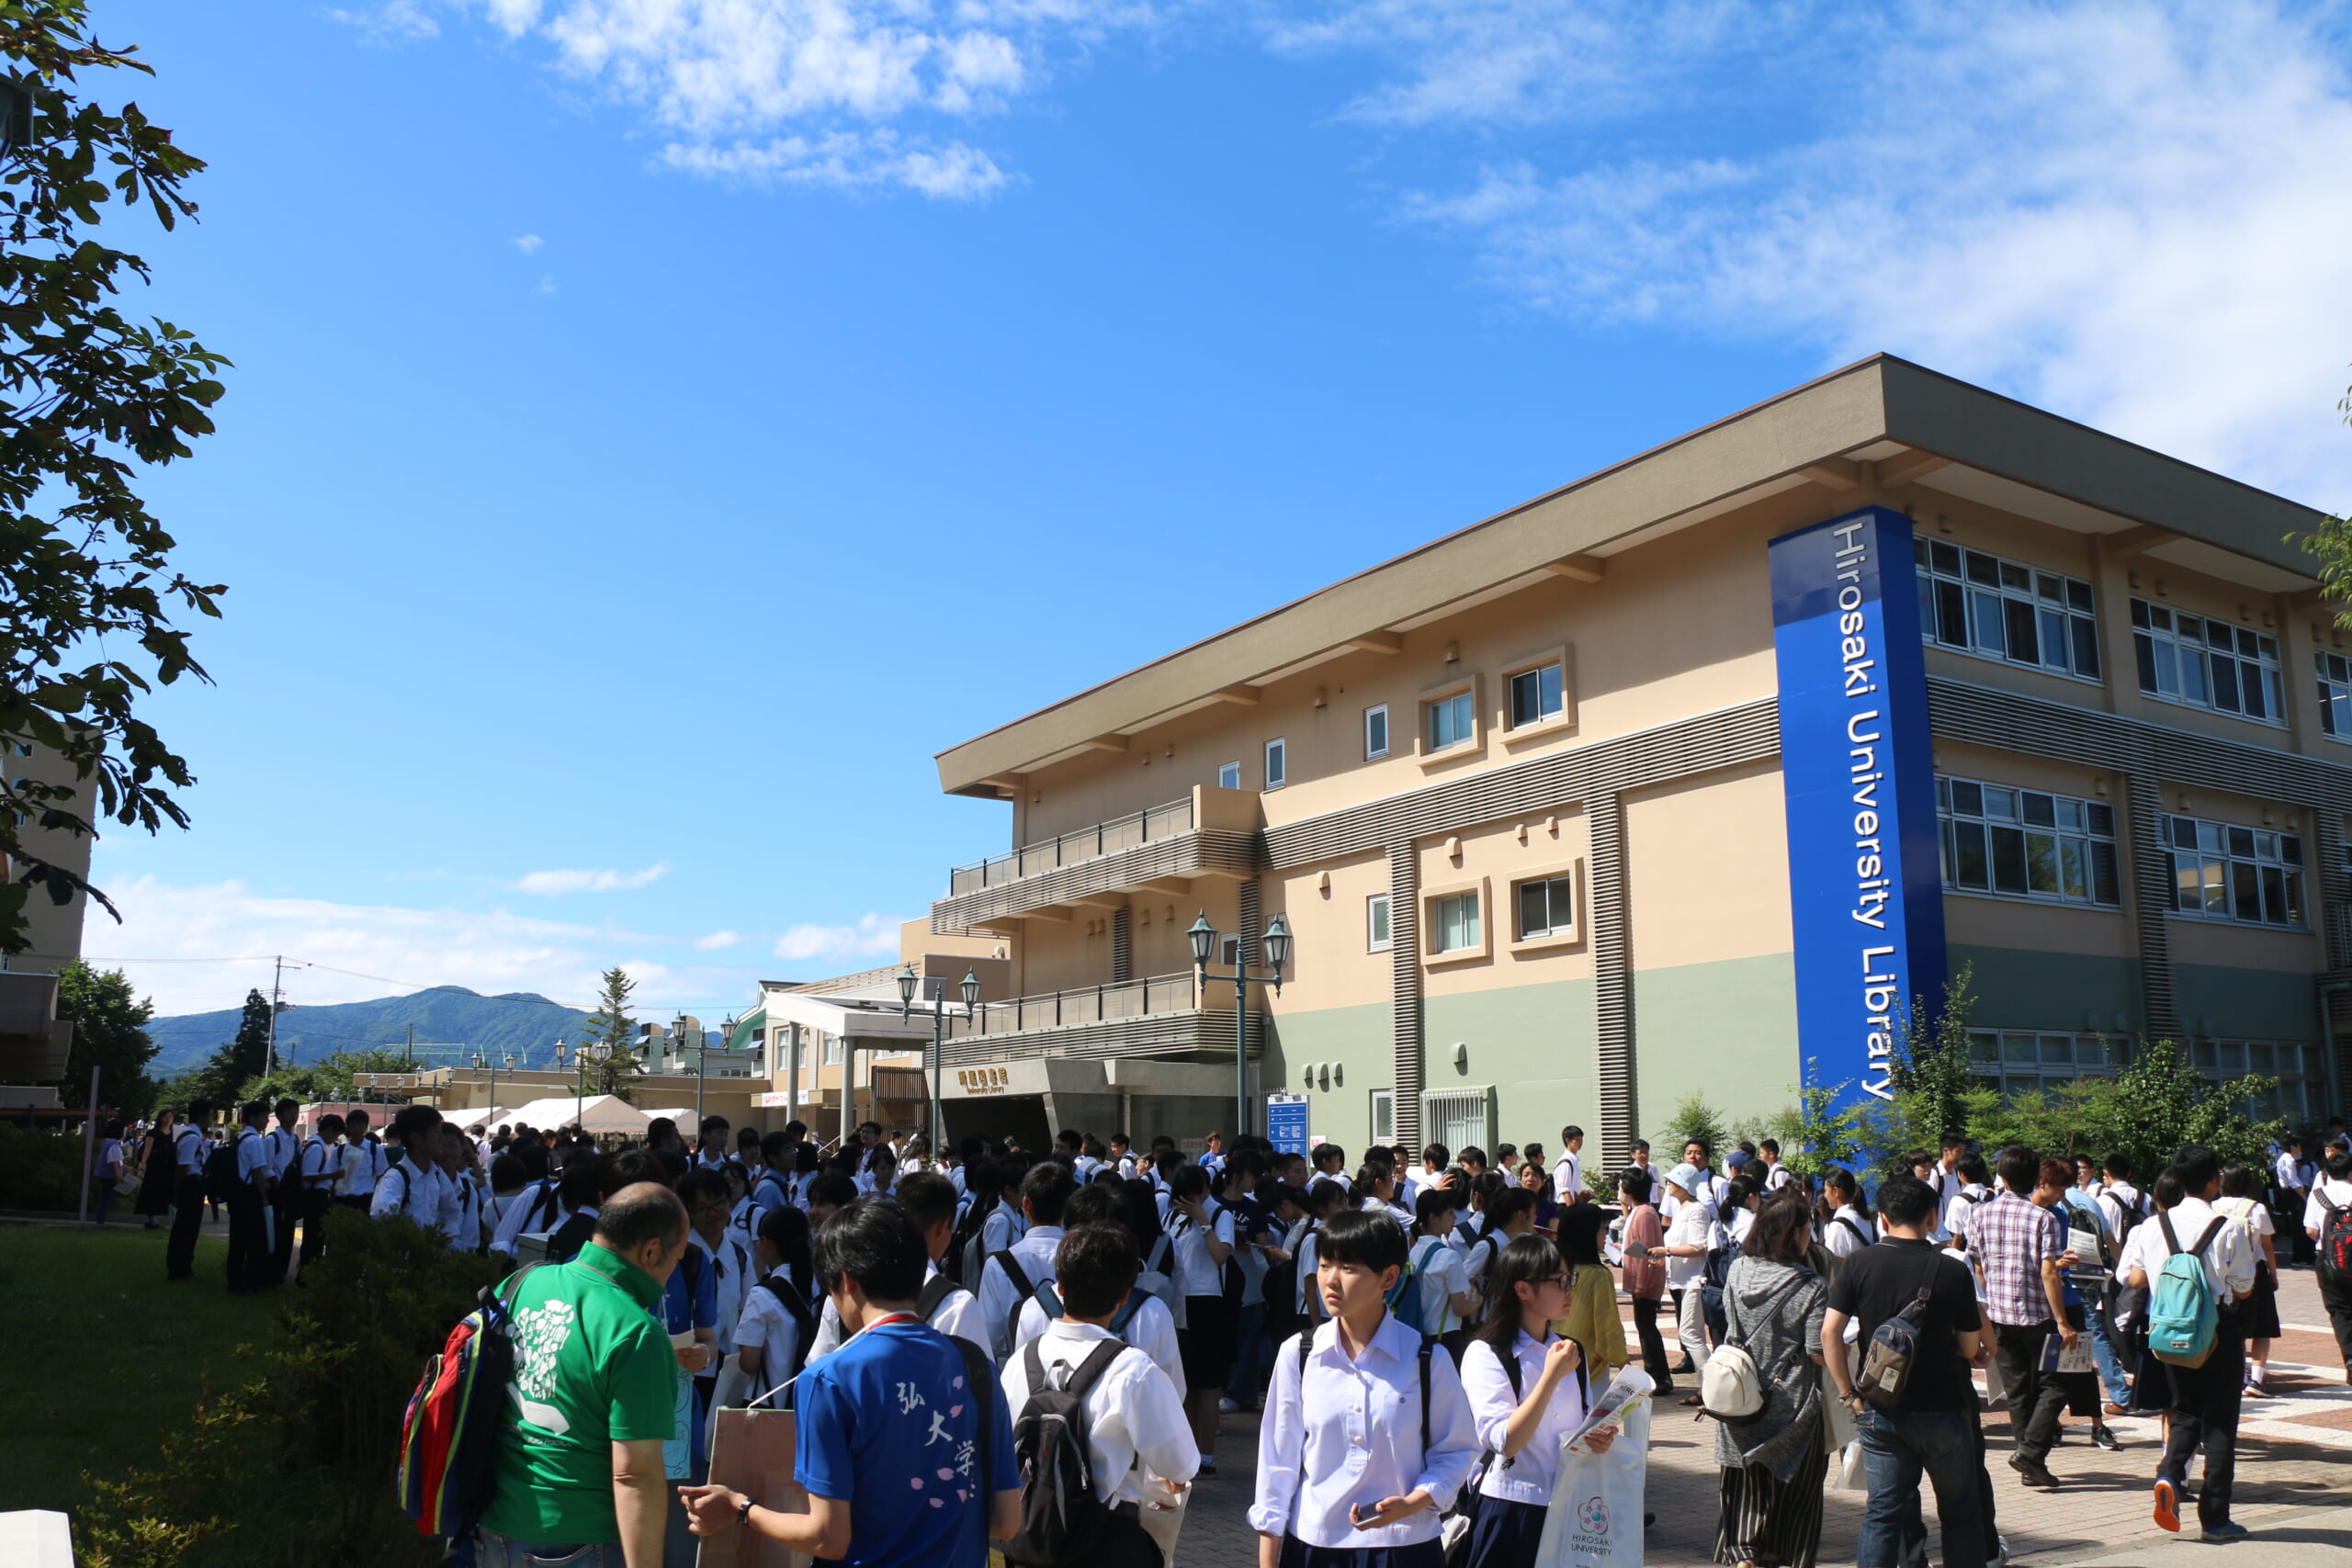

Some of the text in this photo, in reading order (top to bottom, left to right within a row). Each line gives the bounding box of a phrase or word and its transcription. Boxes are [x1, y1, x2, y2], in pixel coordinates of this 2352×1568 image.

[1834, 522, 1897, 1100] Hirosaki University Library
[1572, 1534, 1612, 1546] HIROSAKI
[1571, 1543, 1612, 1556] UNIVERSITY
